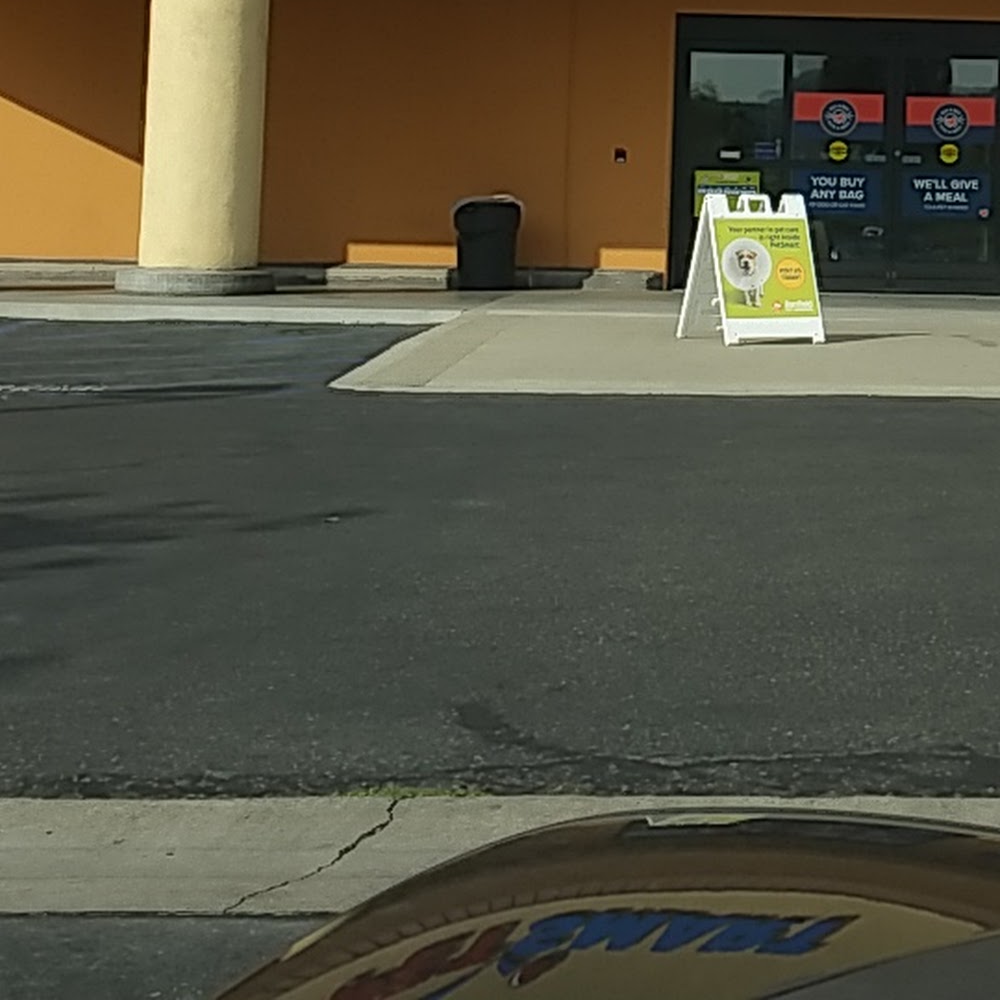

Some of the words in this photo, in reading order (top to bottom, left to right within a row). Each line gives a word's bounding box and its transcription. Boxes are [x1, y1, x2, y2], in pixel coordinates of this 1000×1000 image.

[811, 176, 837, 187] YOU
[839, 177, 866, 188] BUY
[913, 178, 947, 190] WE'LL
[950, 179, 979, 191] GIVE
[810, 189, 837, 200] ANY
[838, 190, 865, 201] BAG
[923, 191, 933, 202] A
[935, 192, 968, 203] MEAL
